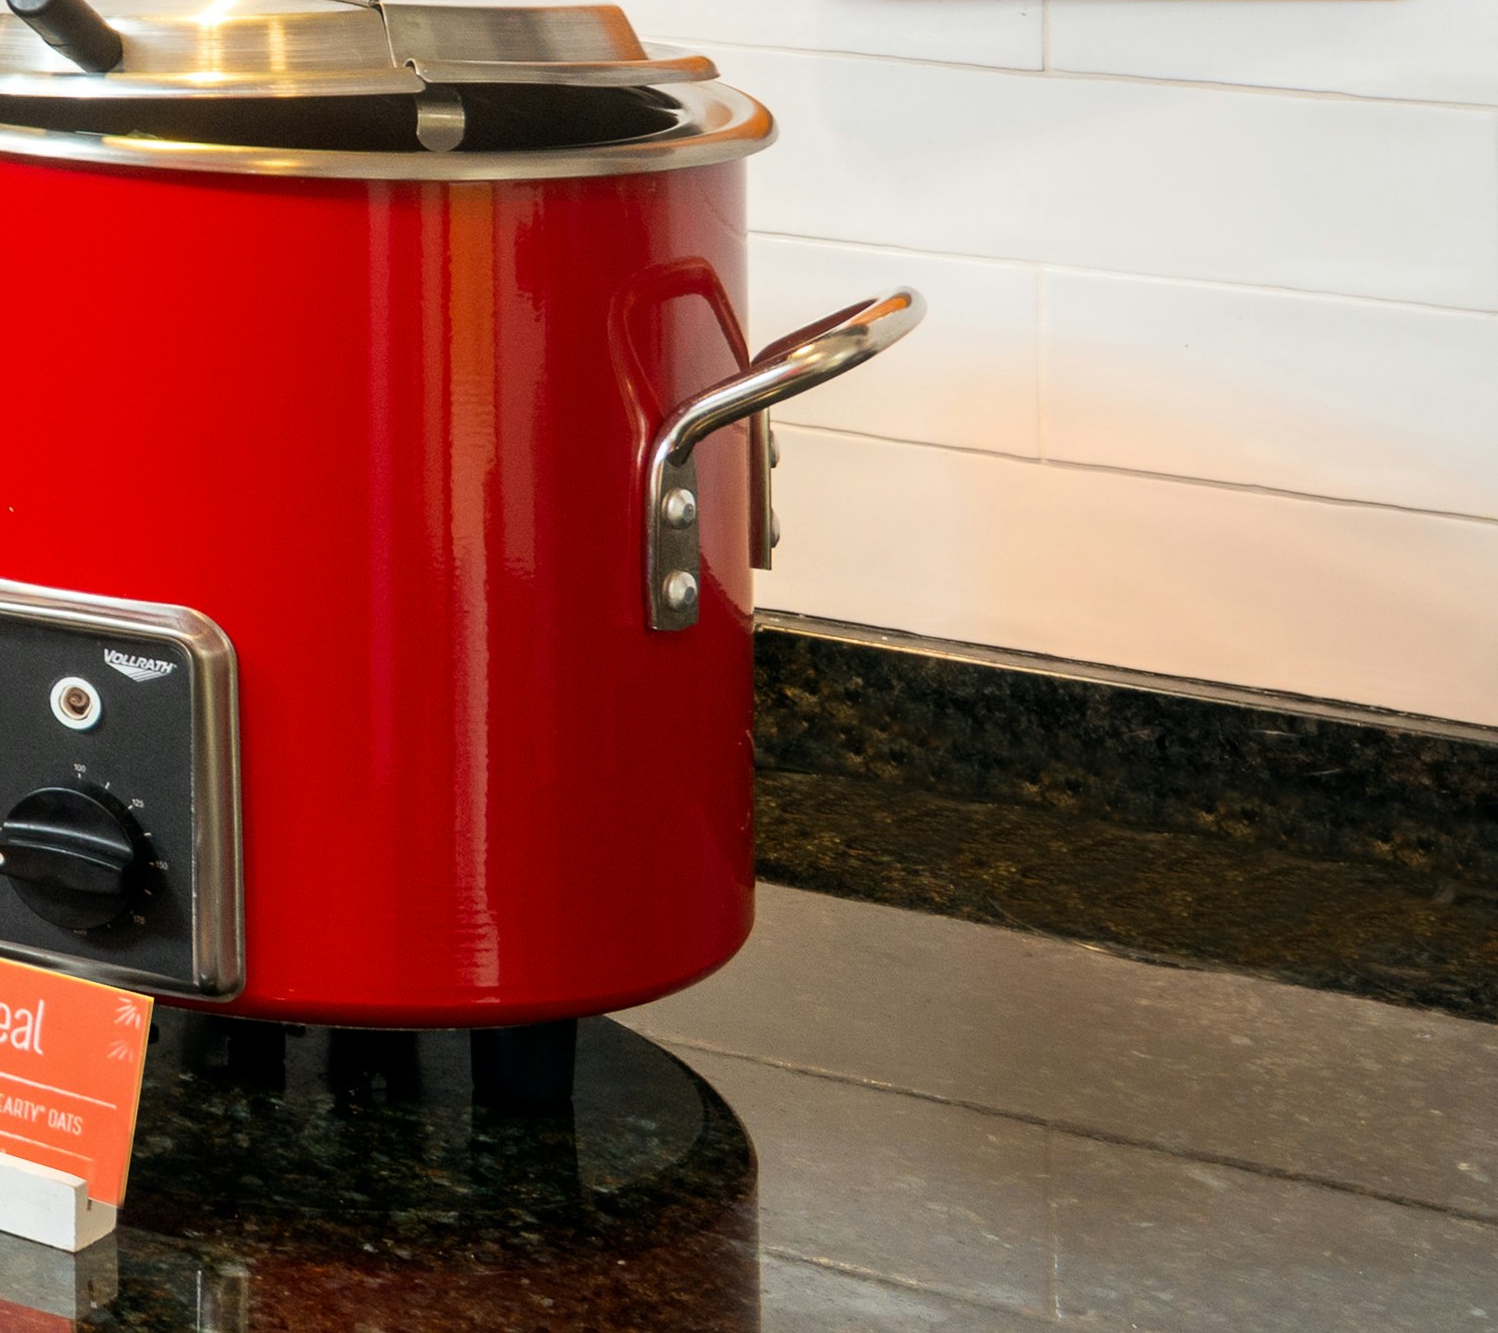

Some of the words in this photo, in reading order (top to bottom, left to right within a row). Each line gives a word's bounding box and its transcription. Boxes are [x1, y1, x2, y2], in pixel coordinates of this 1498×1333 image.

[104, 648, 173, 674] VOLLRATH
[73, 763, 87, 773] 100
[131, 798, 144, 808] 125
[48, 1109, 83, 1135] OATS
